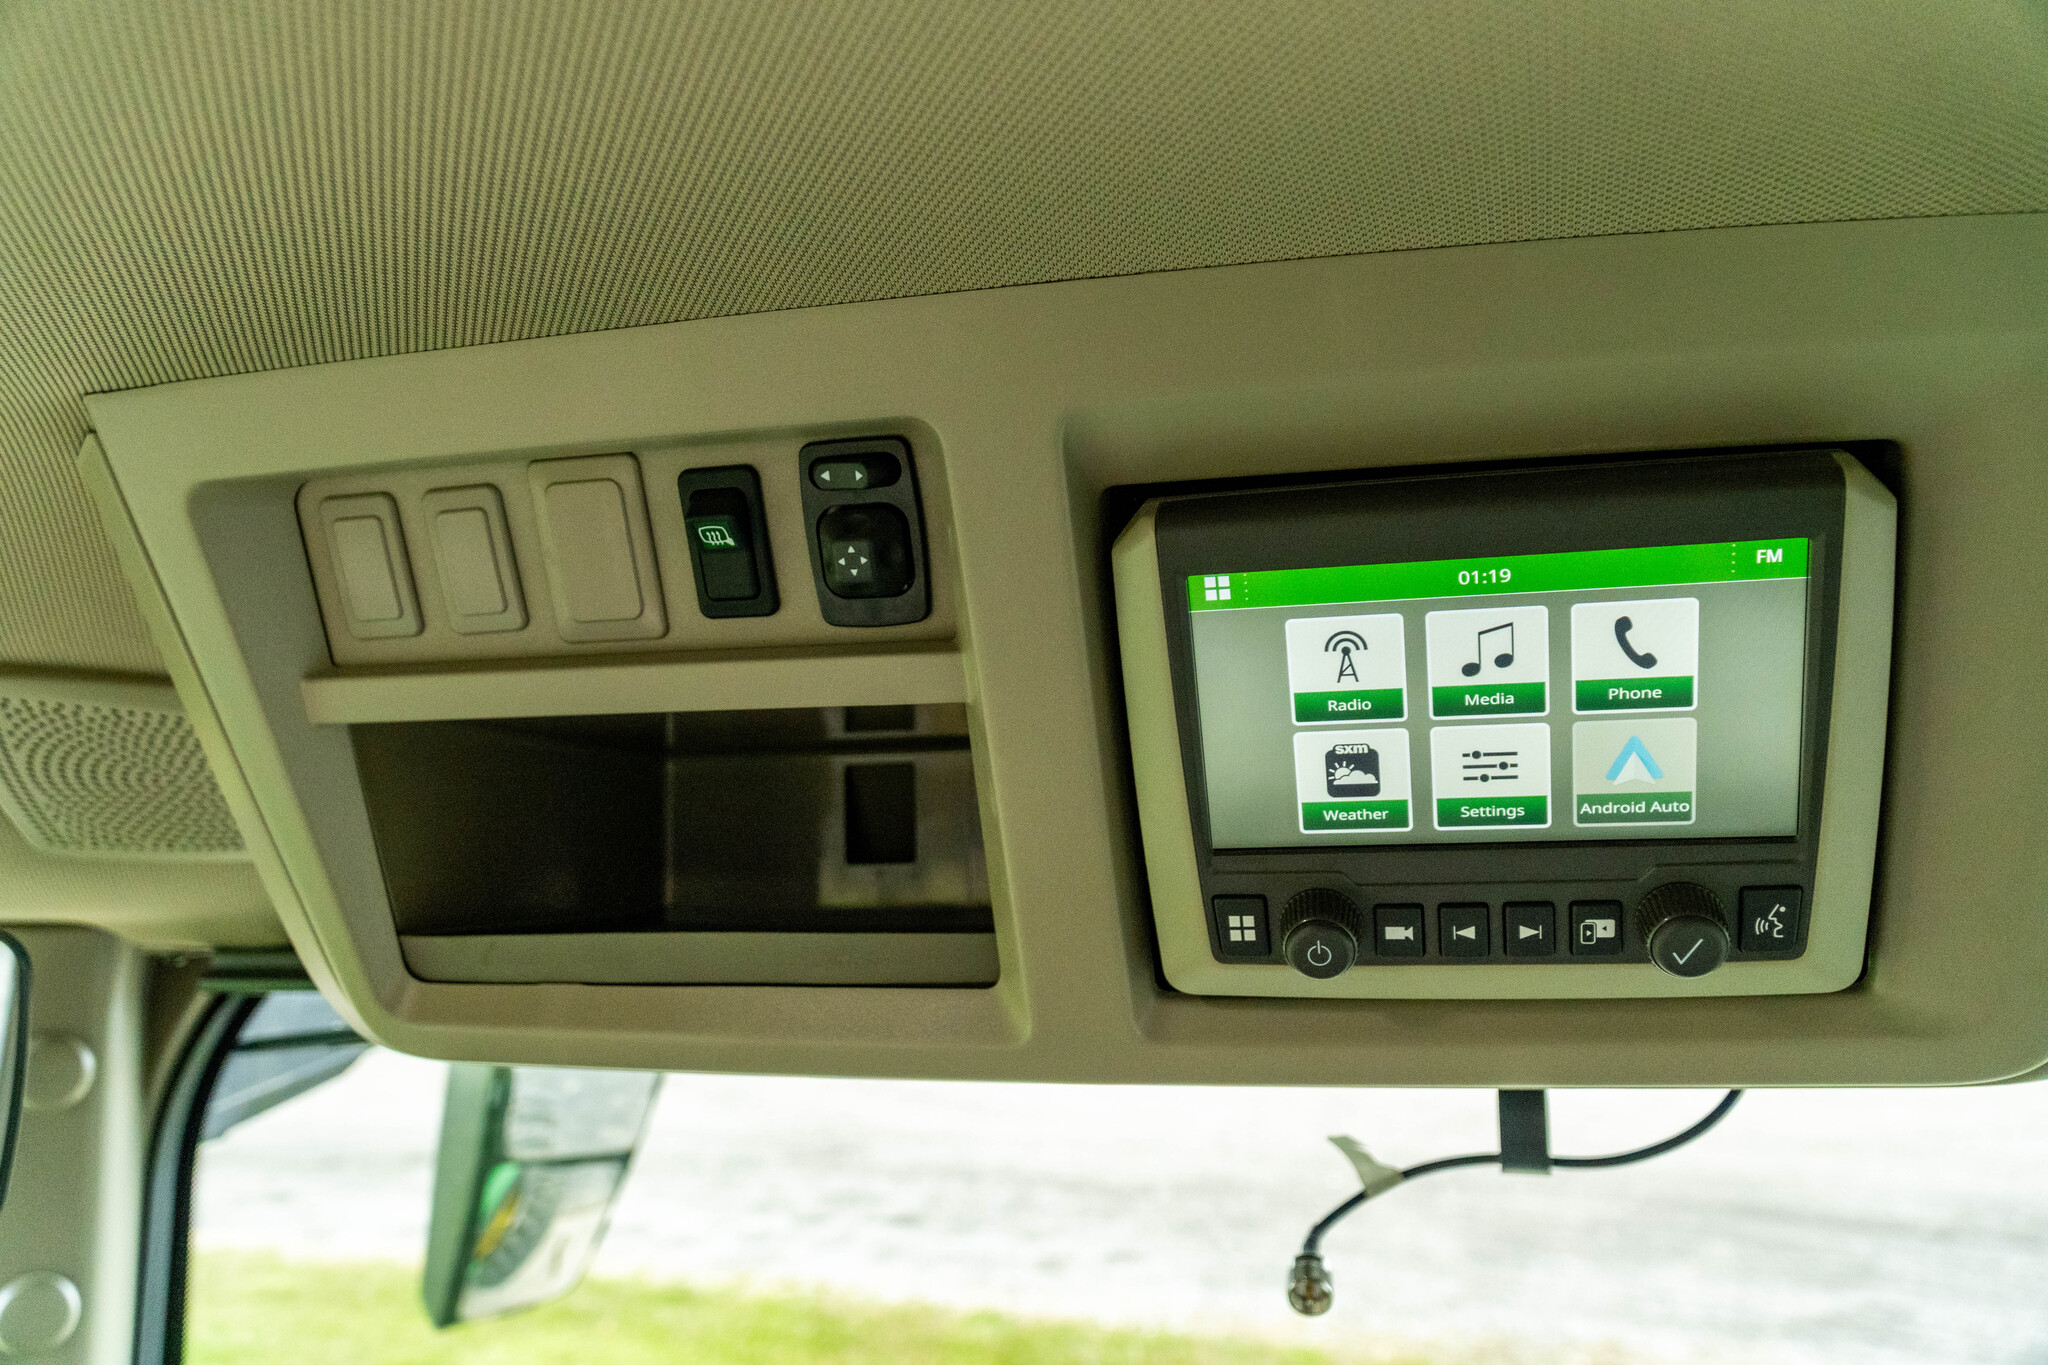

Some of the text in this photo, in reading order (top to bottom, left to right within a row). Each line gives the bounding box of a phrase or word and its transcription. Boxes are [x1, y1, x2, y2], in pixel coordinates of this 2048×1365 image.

[1755, 549, 1784, 564] FM
[1458, 568, 1512, 586] 01:19
[1464, 691, 1515, 706] Media
[1608, 685, 1662, 701] Phone
[1327, 698, 1372, 712] Radio
[1334, 743, 1369, 755] sxm
[1323, 806, 1389, 822] Weather
[1460, 804, 1525, 820] Settings
[1580, 800, 1690, 815] Android Auto
